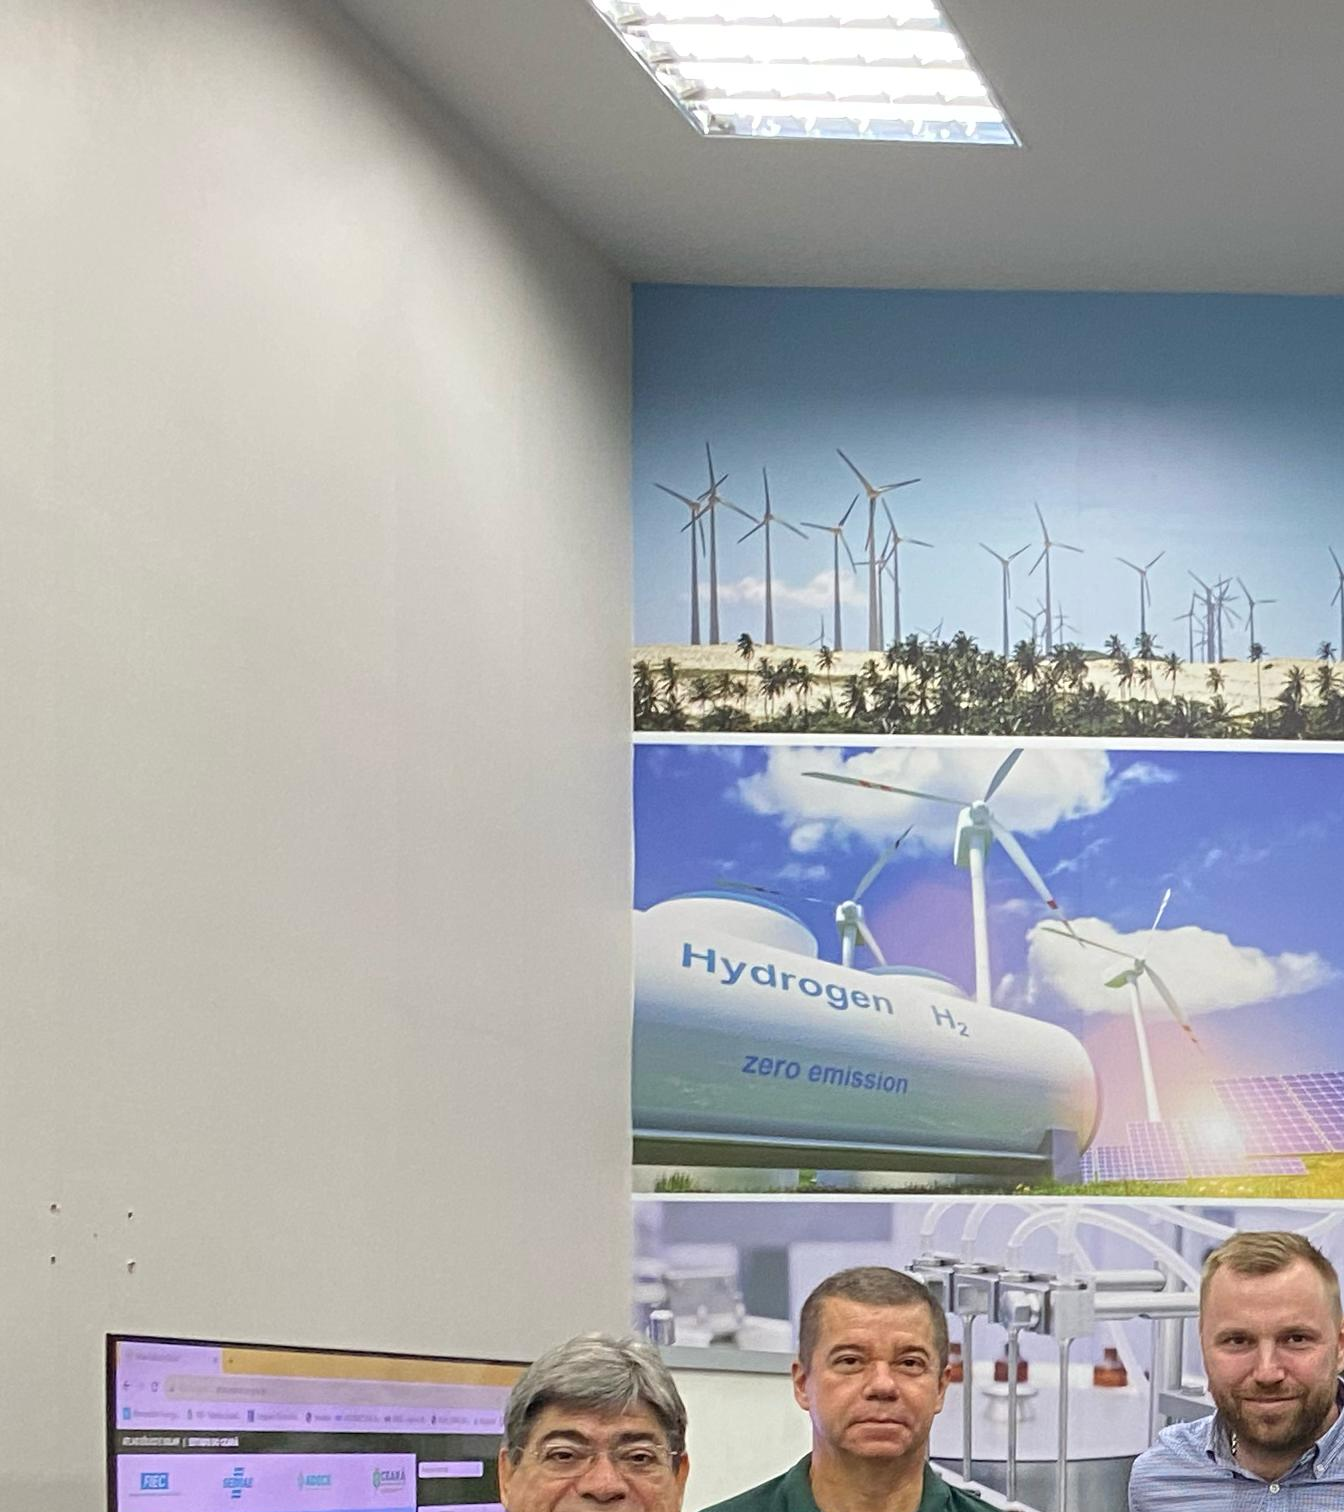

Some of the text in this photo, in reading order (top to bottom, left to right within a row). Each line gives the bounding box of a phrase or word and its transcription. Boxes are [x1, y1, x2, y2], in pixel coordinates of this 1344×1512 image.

[682, 942, 894, 1014] Hydrogen
[742, 1055, 909, 1094] zero emission
